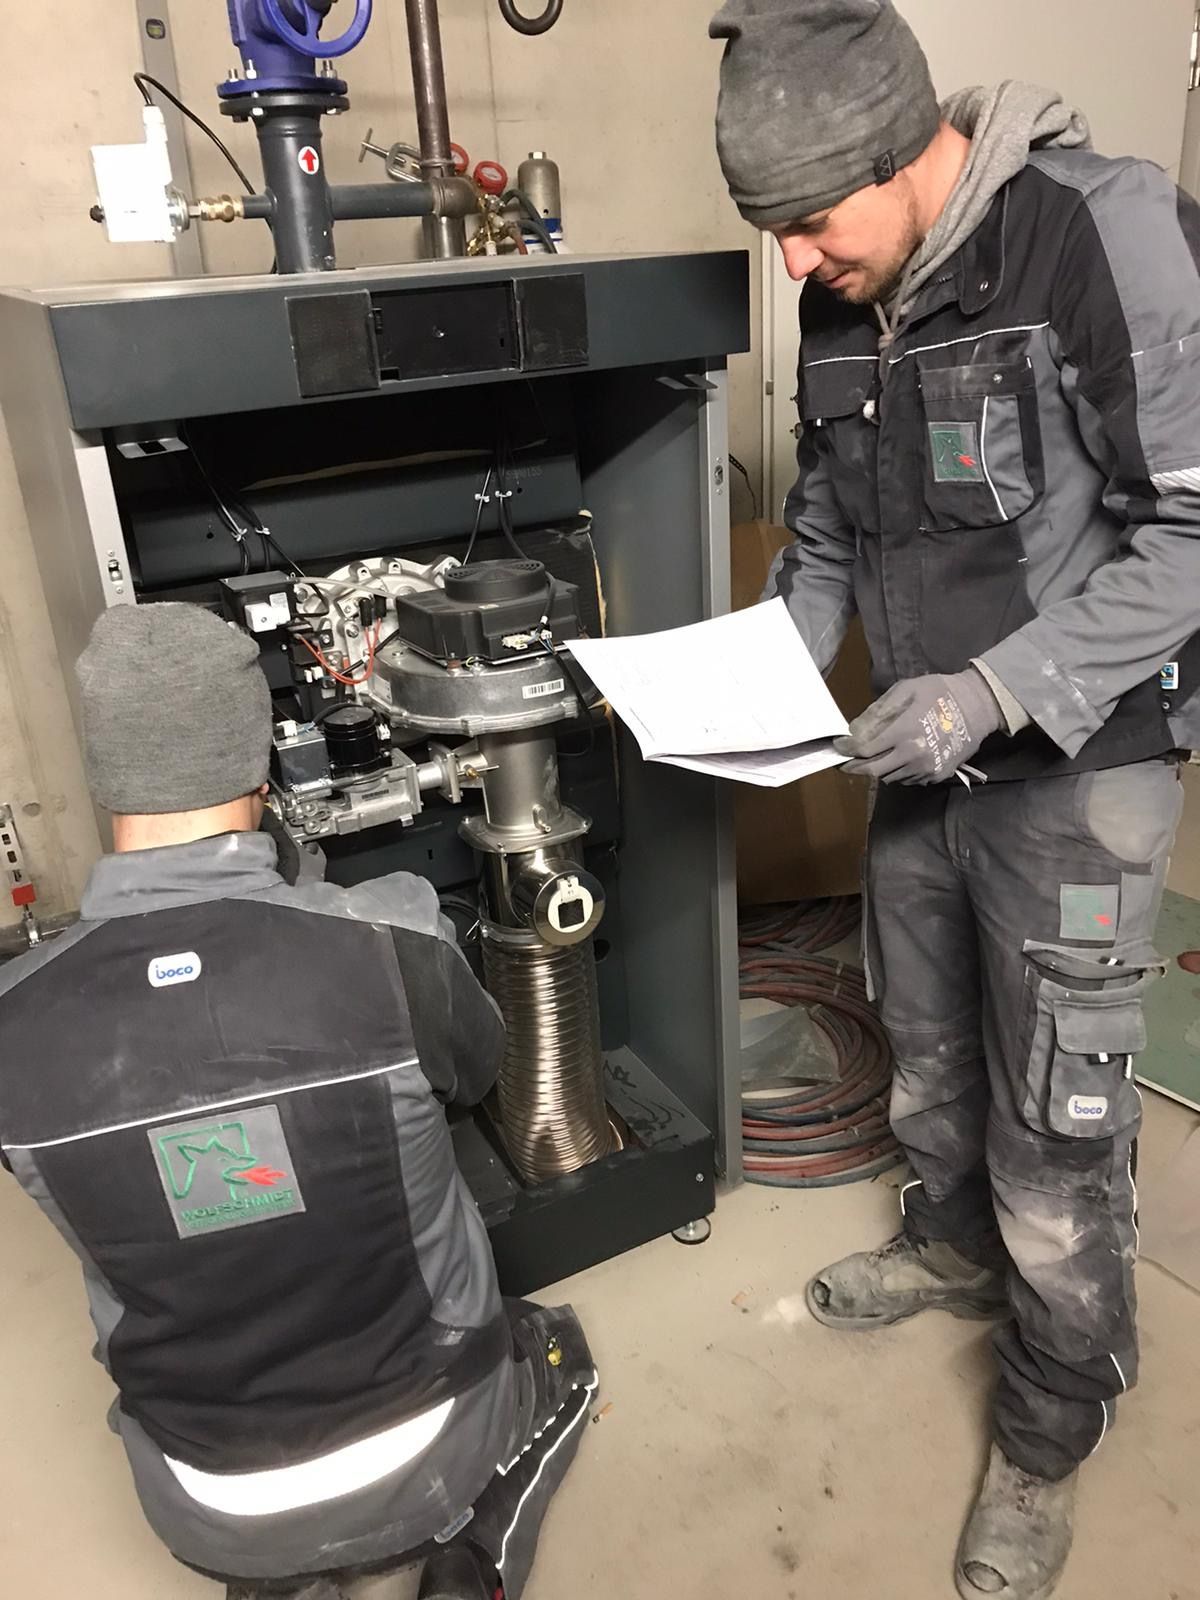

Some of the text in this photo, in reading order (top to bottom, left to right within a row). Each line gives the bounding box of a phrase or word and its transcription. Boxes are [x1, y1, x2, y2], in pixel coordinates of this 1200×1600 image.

[919, 716, 944, 772] MaxiFlex
[155, 964, 194, 980] boco
[1074, 1100, 1103, 1115] boco
[181, 1188, 293, 1221] WOLFSCHMIDT
